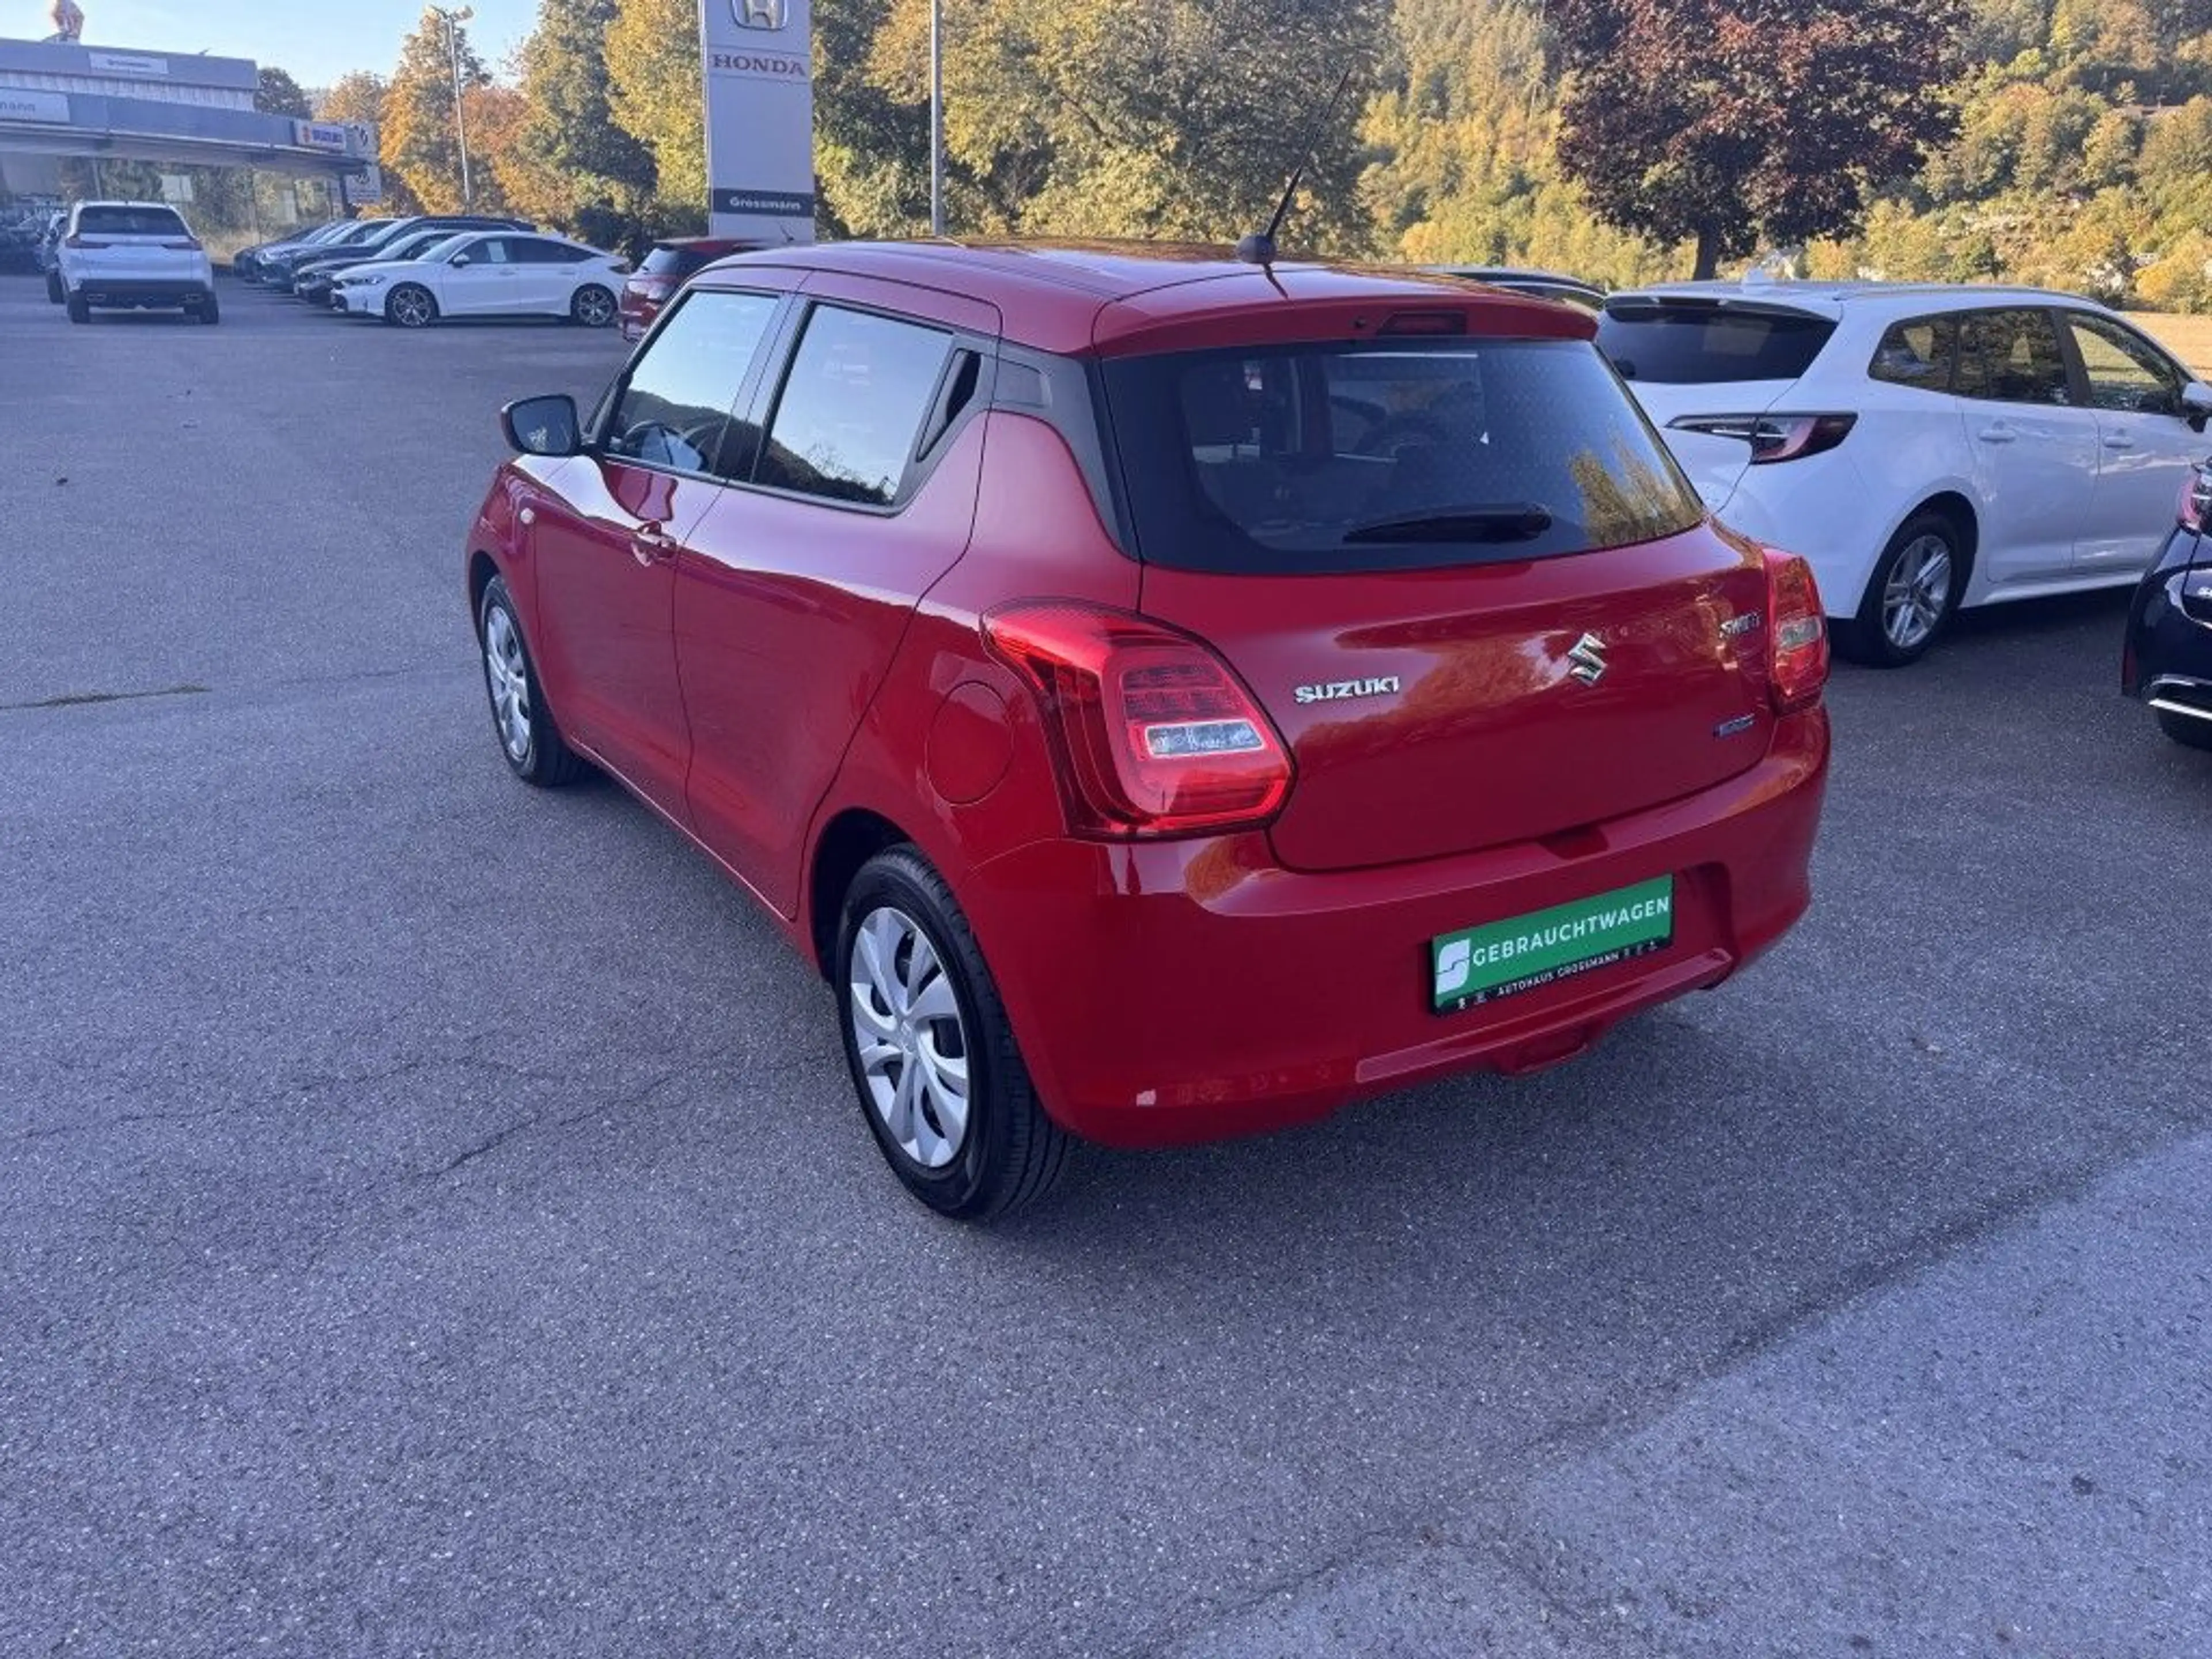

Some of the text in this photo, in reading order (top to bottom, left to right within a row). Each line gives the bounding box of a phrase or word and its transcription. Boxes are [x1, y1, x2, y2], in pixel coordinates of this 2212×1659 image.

[712, 54, 806, 76] HONDA
[729, 196, 802, 211] Grossmann
[1294, 675, 1400, 704] SUZUKI
[1472, 896, 1669, 967] GEBRAUCHTWAGEN
[1497, 971, 1555, 997] AUTOHAUS
